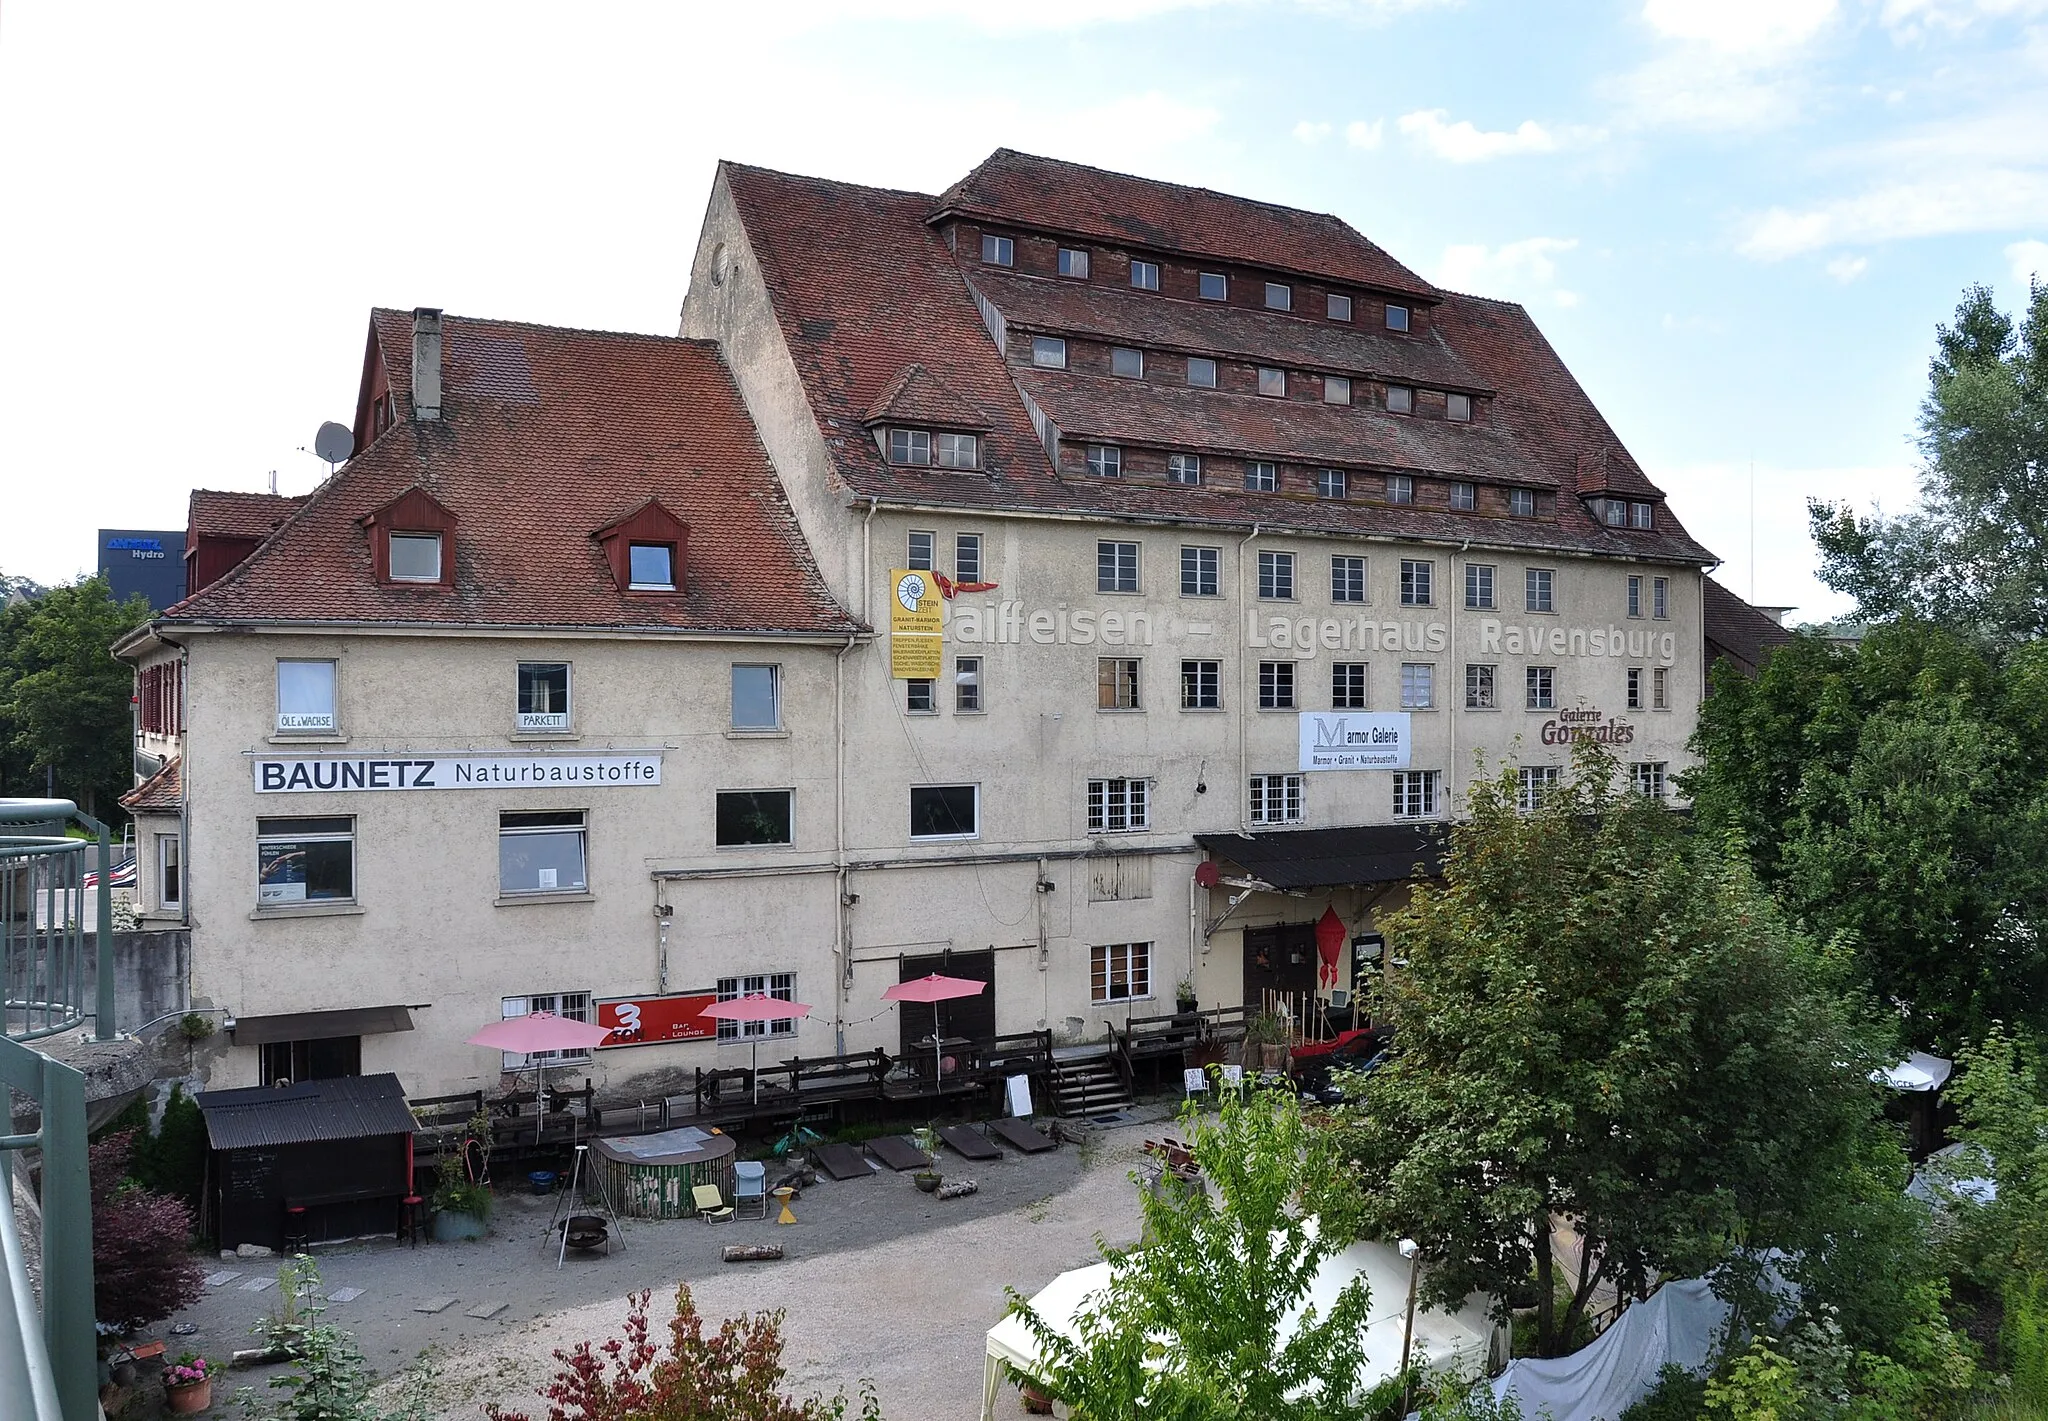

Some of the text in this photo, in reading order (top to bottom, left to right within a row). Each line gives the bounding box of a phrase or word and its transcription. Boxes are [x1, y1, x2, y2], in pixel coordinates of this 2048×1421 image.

[132, 550, 165, 560] Hydro
[1249, 609, 1446, 659] Lagerhaus
[1480, 617, 1676, 667] Ravensburg
[281, 715, 296, 726] ÖLE
[301, 716, 331, 726] WACHSE
[523, 715, 562, 726] PARKETT
[1560, 706, 1602, 722] Galerie
[1372, 727, 1398, 743] Galerie
[1313, 754, 1398, 765] Marmor Granit Naturbaustoffe
[262, 760, 655, 790] BAUNETZ Naturbaustoffe
[614, 1003, 641, 1035] 3
